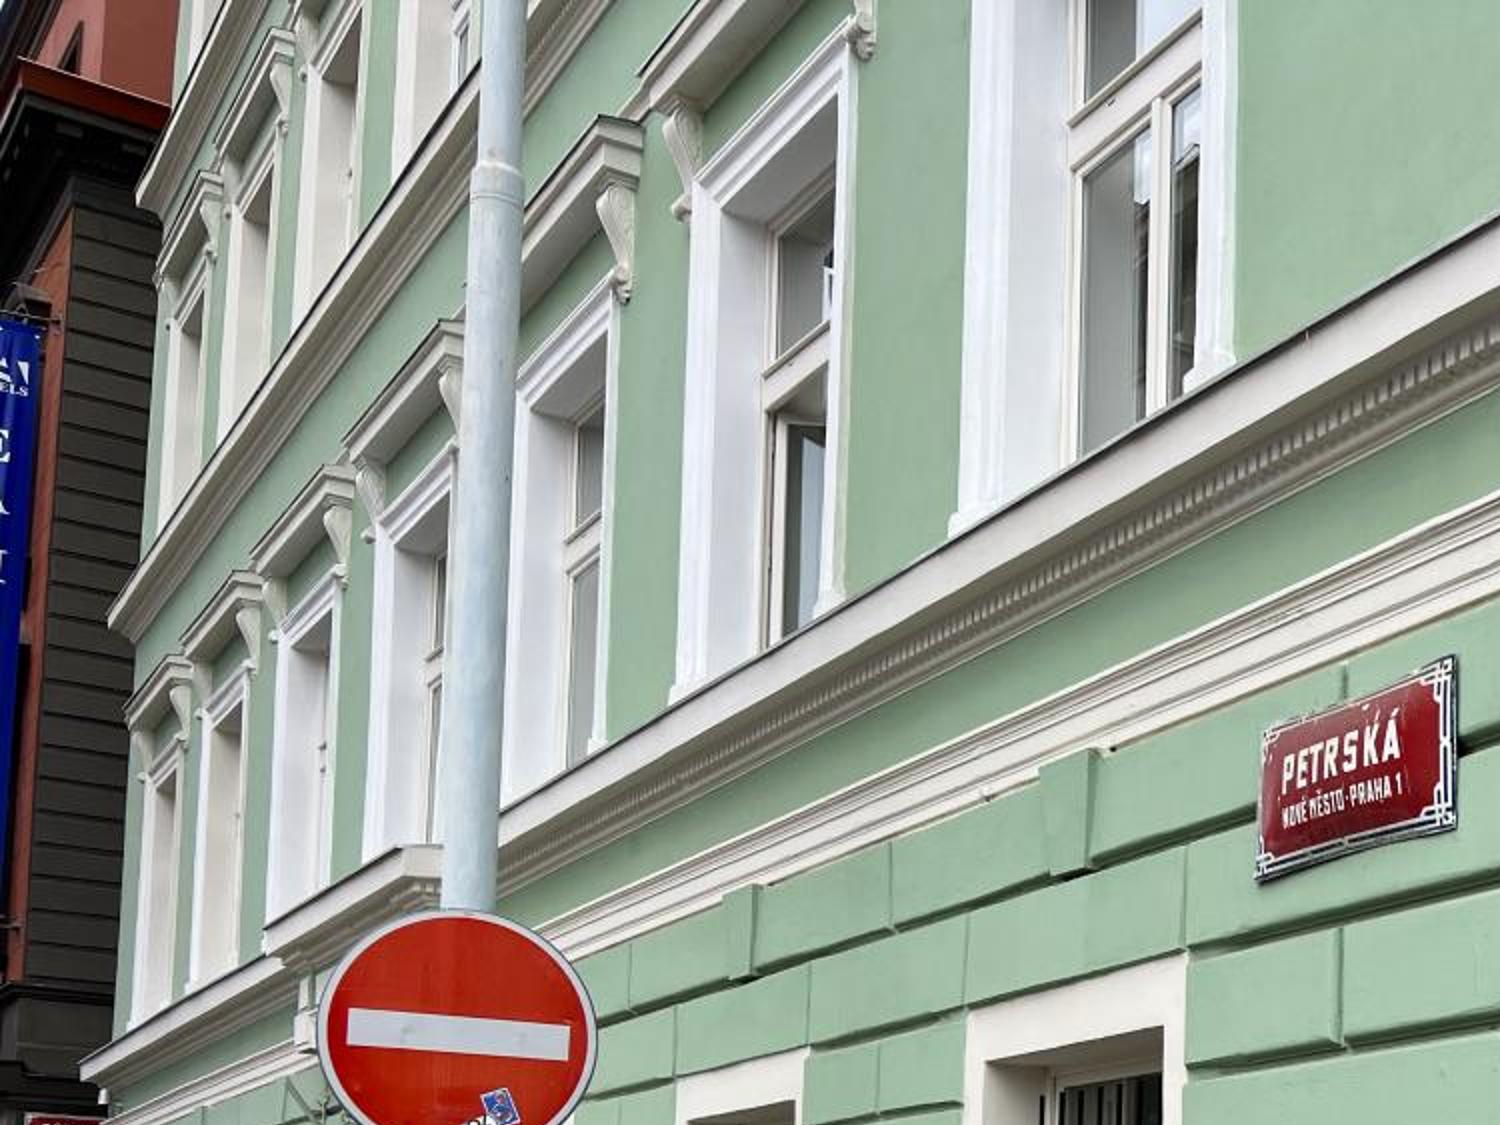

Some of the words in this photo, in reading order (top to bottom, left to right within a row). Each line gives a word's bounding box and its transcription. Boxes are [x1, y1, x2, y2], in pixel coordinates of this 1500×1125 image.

[1281, 707, 1401, 796] PETRSKÁ
[1281, 796, 1309, 830] NOVÉ
[1349, 775, 1392, 808] PRAHA
[1395, 771, 1403, 796] 1
